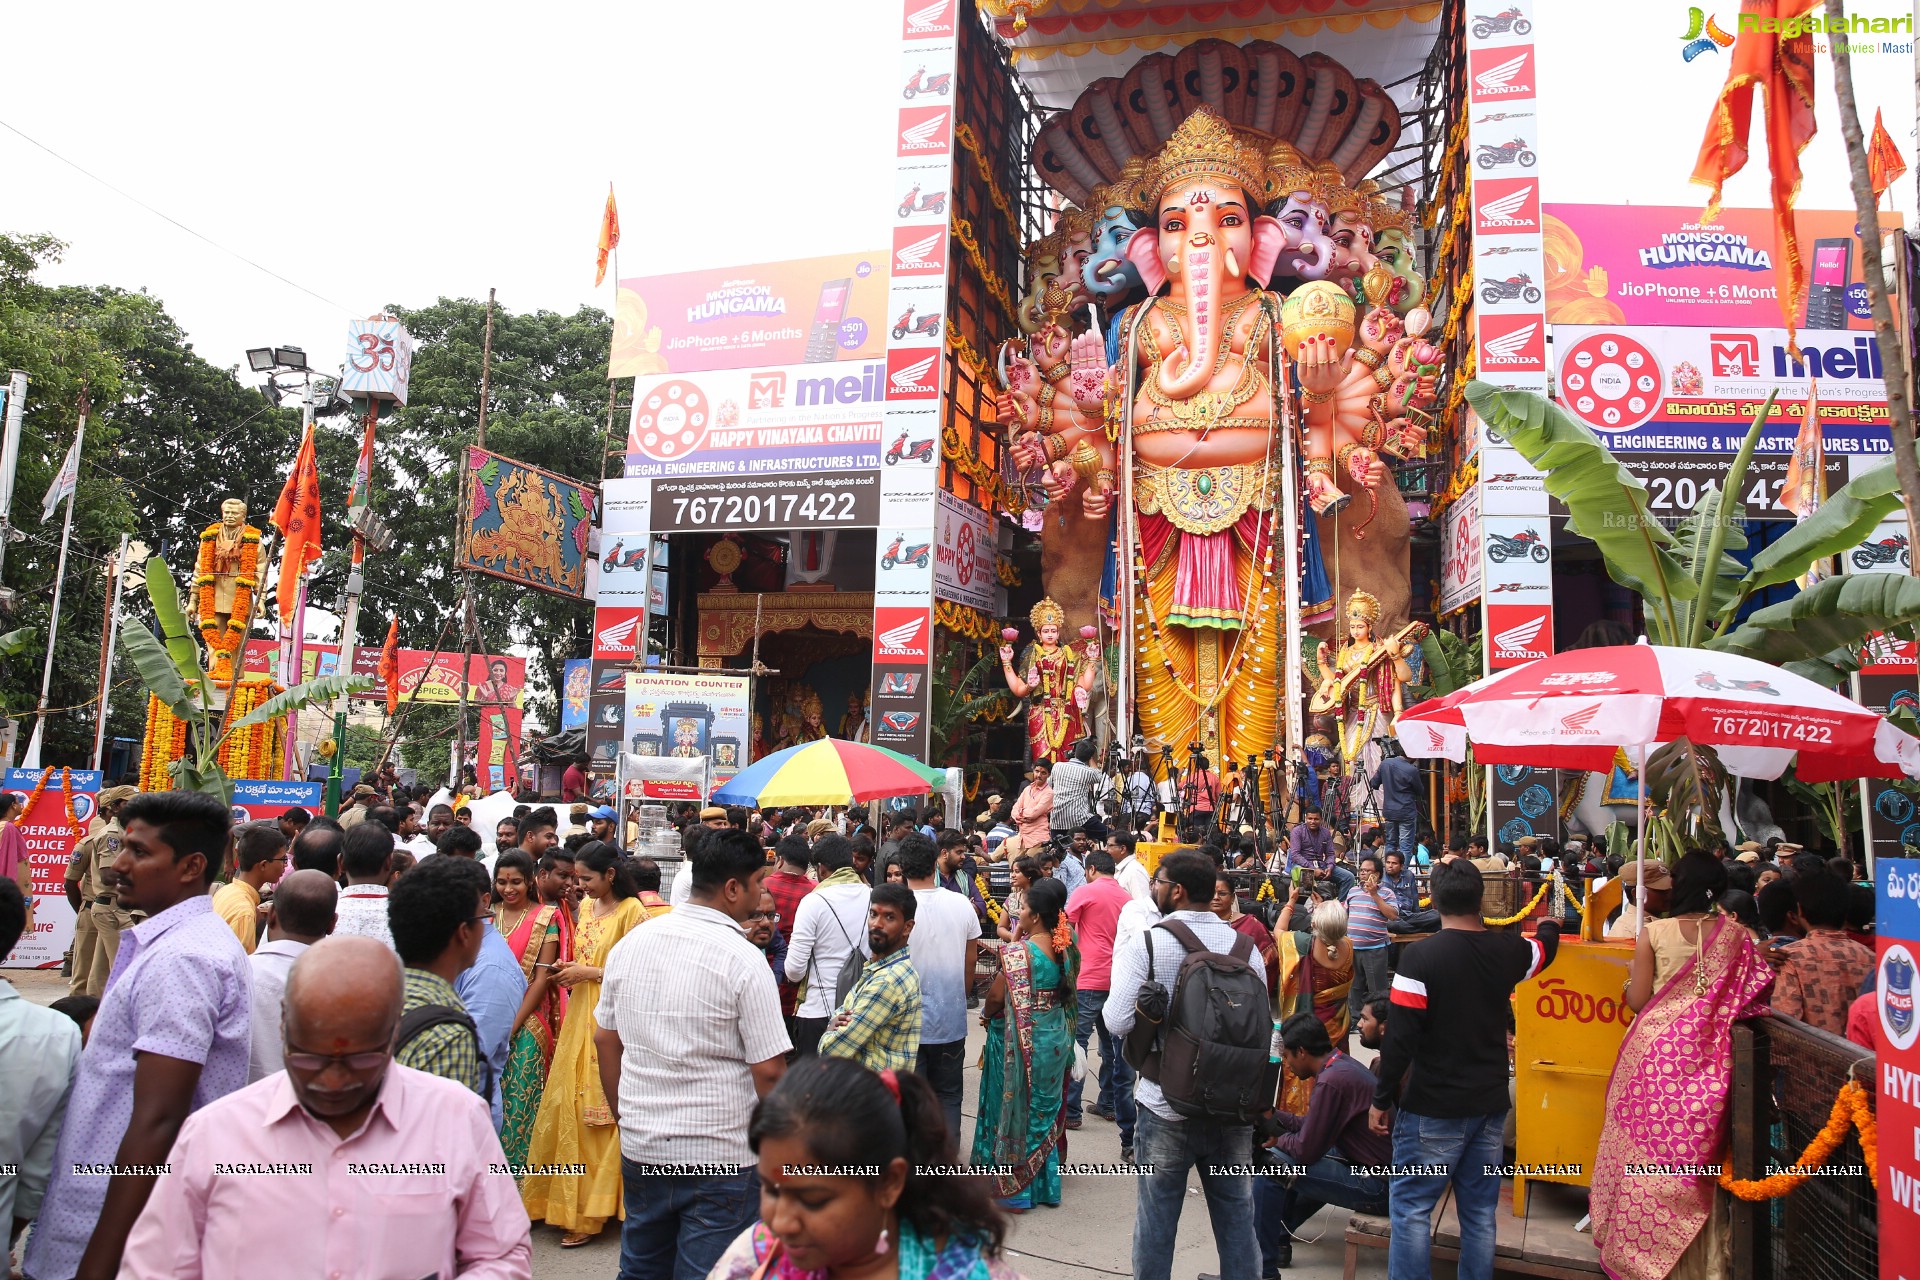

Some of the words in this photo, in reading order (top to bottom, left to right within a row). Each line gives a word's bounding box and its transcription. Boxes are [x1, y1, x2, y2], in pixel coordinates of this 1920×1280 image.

[906, 24, 951, 34] HONDA
[1475, 85, 1531, 96] HONDA
[901, 141, 946, 150] HONDA
[1480, 218, 1535, 228] HONDA
[1661, 233, 1748, 246] MONSOON
[1639, 245, 1772, 269] HUNGAMA
[857, 266, 870, 274] Jio
[896, 261, 941, 270] HONDA
[722, 279, 755, 287] JioPhone
[706, 285, 771, 301] MONSOON
[1617, 283, 1700, 299] JioPhone
[1732, 284, 1777, 299] Mont
[687, 296, 787, 322] HUNGAMA
[666, 334, 728, 351] JioPhone
[752, 326, 803, 342] Months
[1485, 356, 1540, 364] HONDA
[1773, 337, 1883, 379] meil
[795, 364, 885, 406] meil
[890, 385, 935, 394] HONDA
[1714, 386, 1766, 398] Partnering
[1782, 387, 1797, 396] the
[1845, 387, 1887, 398] Progress
[1666, 402, 1736, 416] వినాయక
[710, 430, 754, 448] HAPPY
[757, 426, 824, 446] VINAYAKA
[827, 423, 881, 443] CHAVITI
[1615, 436, 1708, 450] ENGINEERING
[1712, 437, 1722, 450] &
[1864, 438, 1893, 452] LTD.
[627, 464, 662, 476] MEGHA
[665, 461, 735, 475] ENGINEERING
[738, 460, 746, 472] &
[749, 457, 853, 472] INFRASTRUCTURES
[856, 455, 880, 468] LTD.
[1650, 462, 1676, 470] మరింత
[1678, 462, 1717, 470] సమాచారం
[1761, 462, 1776, 470] కాల్
[672, 492, 856, 525] 7672017422
[937, 544, 956, 567] HAPPY
[878, 647, 924, 656] HONDA
[1495, 651, 1548, 659] HONDA
[635, 678, 689, 686] DONATION
[695, 681, 742, 689] COUNTER
[418, 687, 450, 696] SPICES
[1712, 716, 1833, 744] 7672017422
[26, 840, 65, 850] OLICE
[1887, 867, 1905, 899] మీ
[1887, 991, 1913, 1008] POLICE
